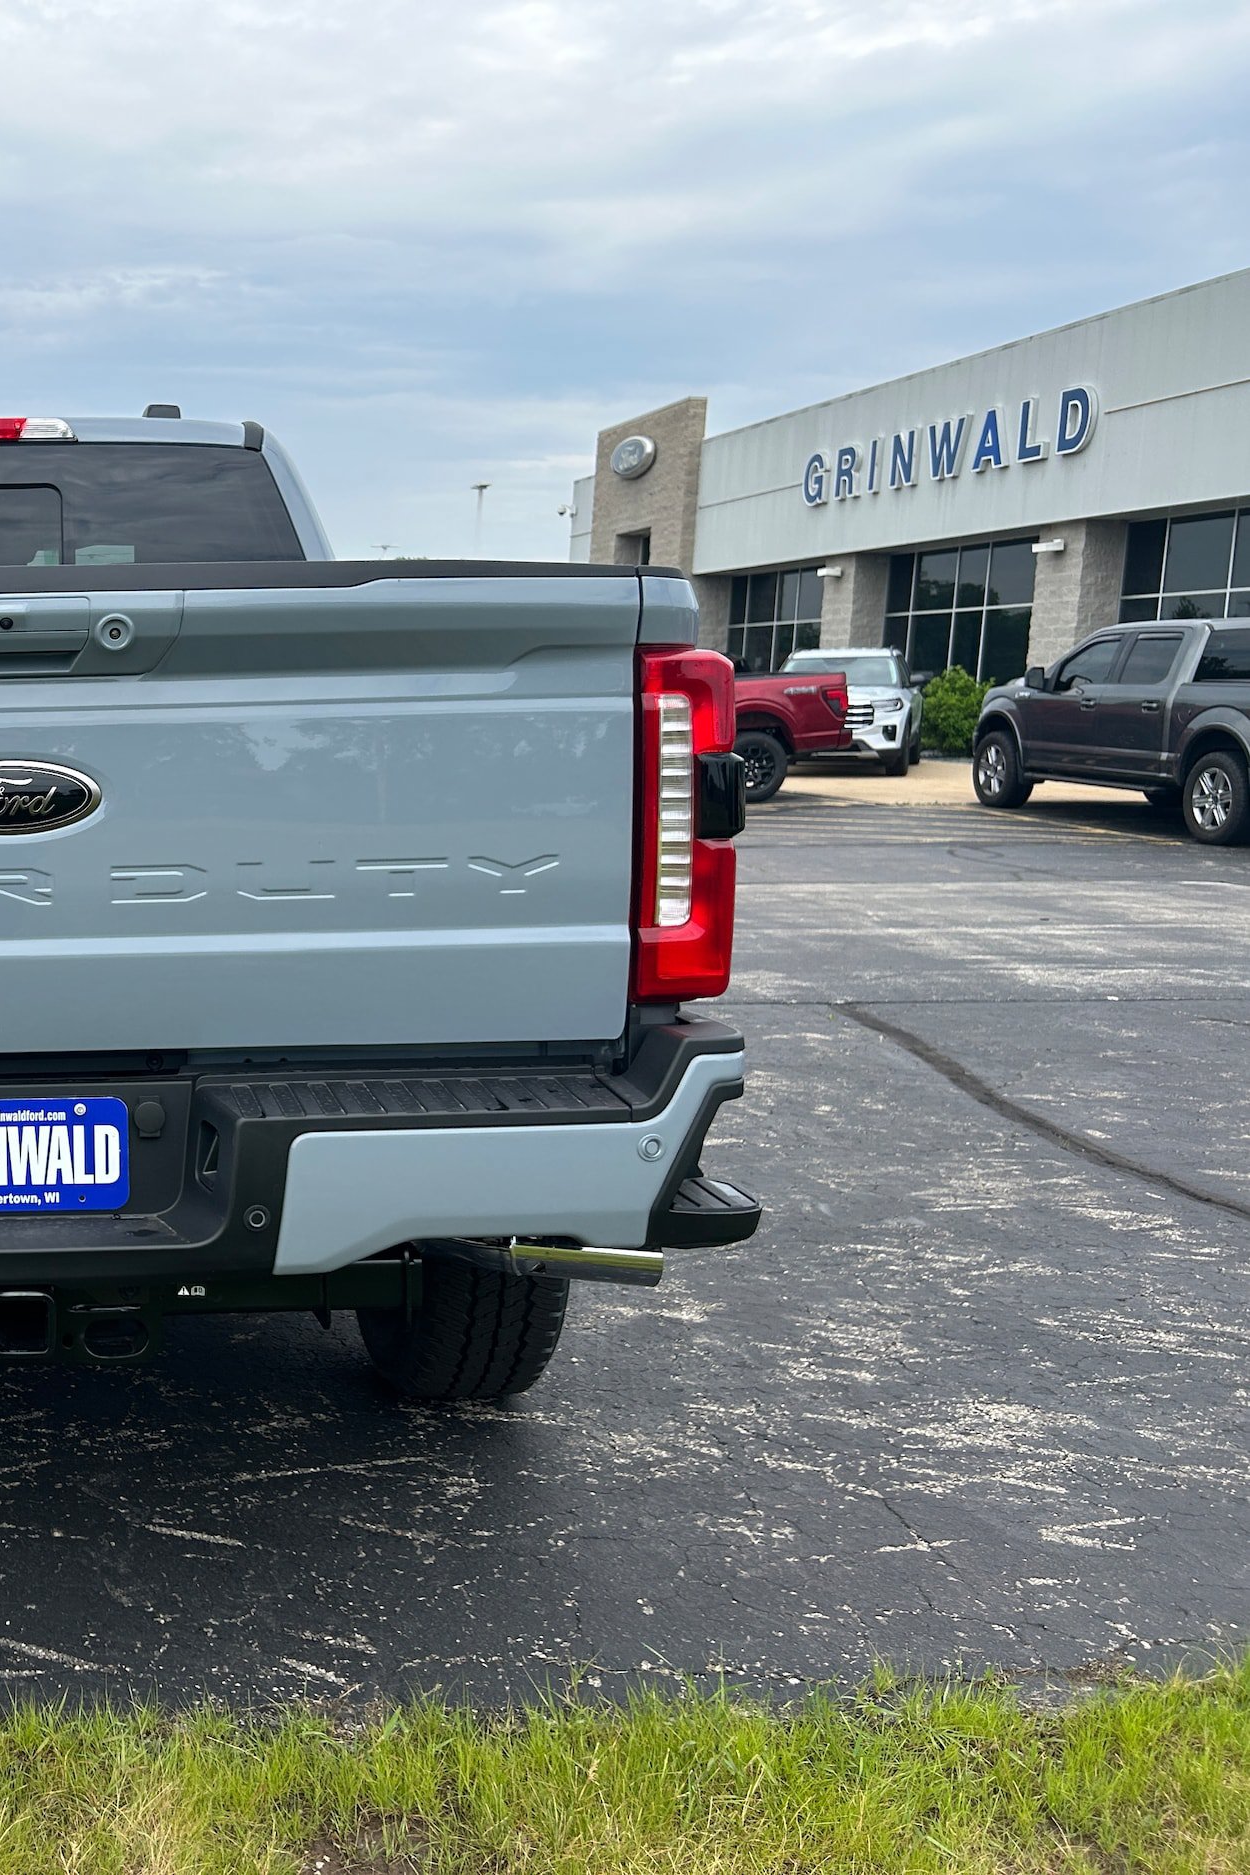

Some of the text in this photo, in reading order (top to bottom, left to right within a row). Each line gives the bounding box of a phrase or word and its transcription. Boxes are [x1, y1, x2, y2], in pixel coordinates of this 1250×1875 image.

[802, 385, 1099, 507] GRINWALD
[110, 853, 560, 904] DUTY
[43, 1191, 60, 1204] WI
